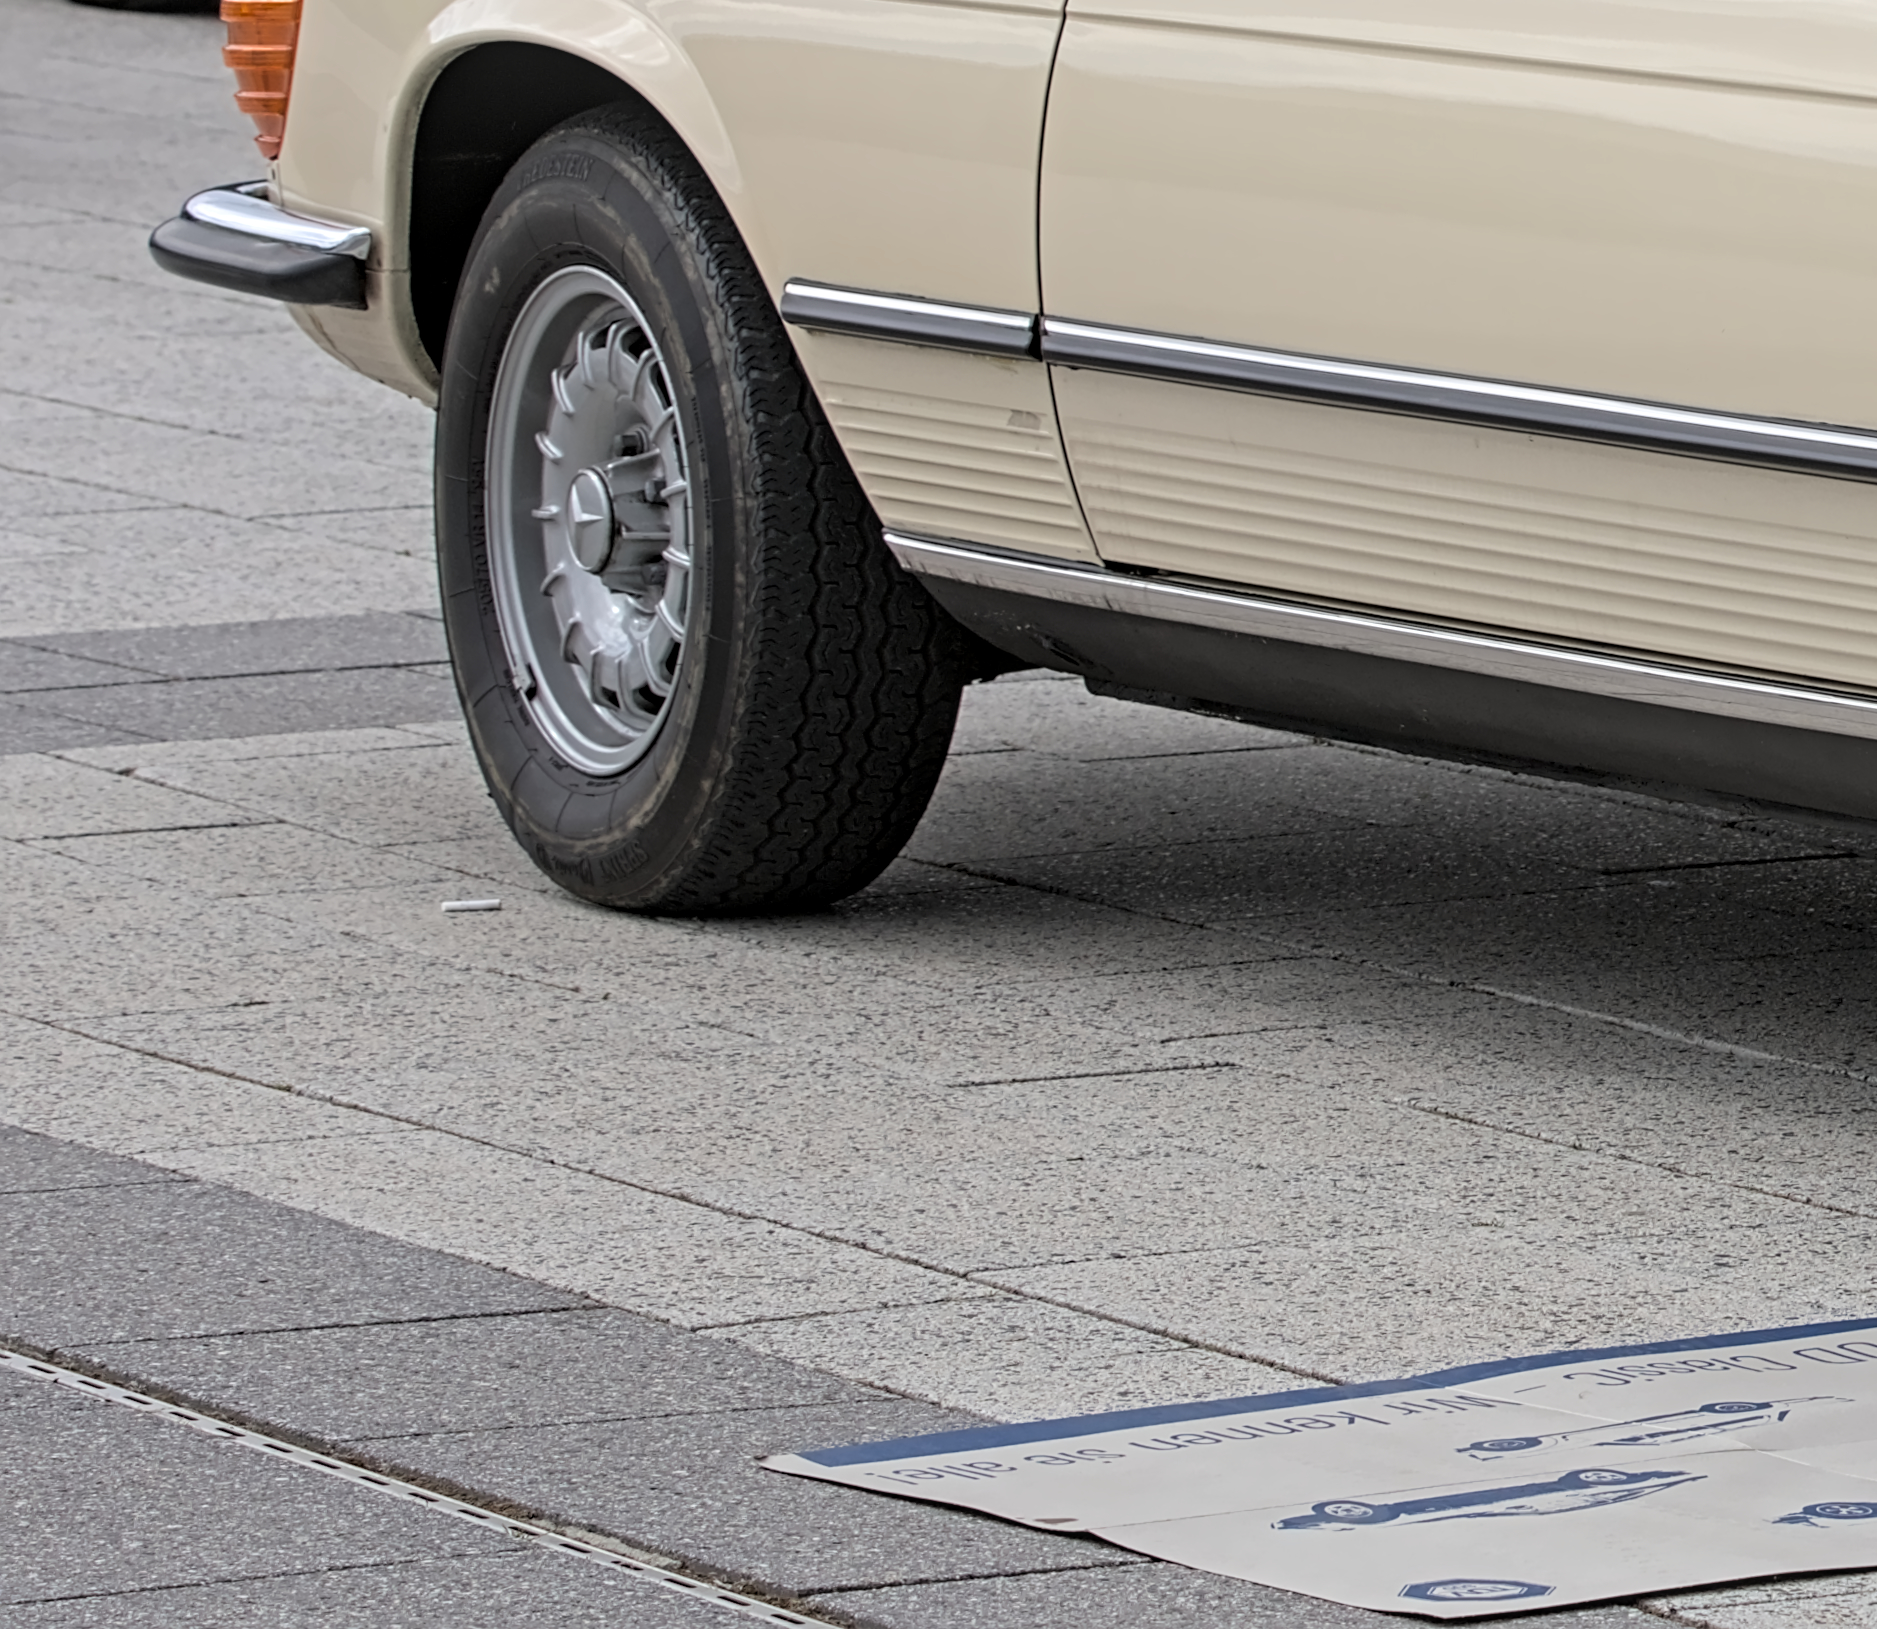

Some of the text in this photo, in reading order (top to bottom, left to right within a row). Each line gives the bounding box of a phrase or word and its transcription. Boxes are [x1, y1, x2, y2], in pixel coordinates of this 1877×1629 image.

[1383, 1395, 1522, 1415] Wir
[1128, 1410, 1391, 1452] kennen
[1024, 1447, 1126, 1465] sie
[872, 1460, 1018, 1486] alle!
